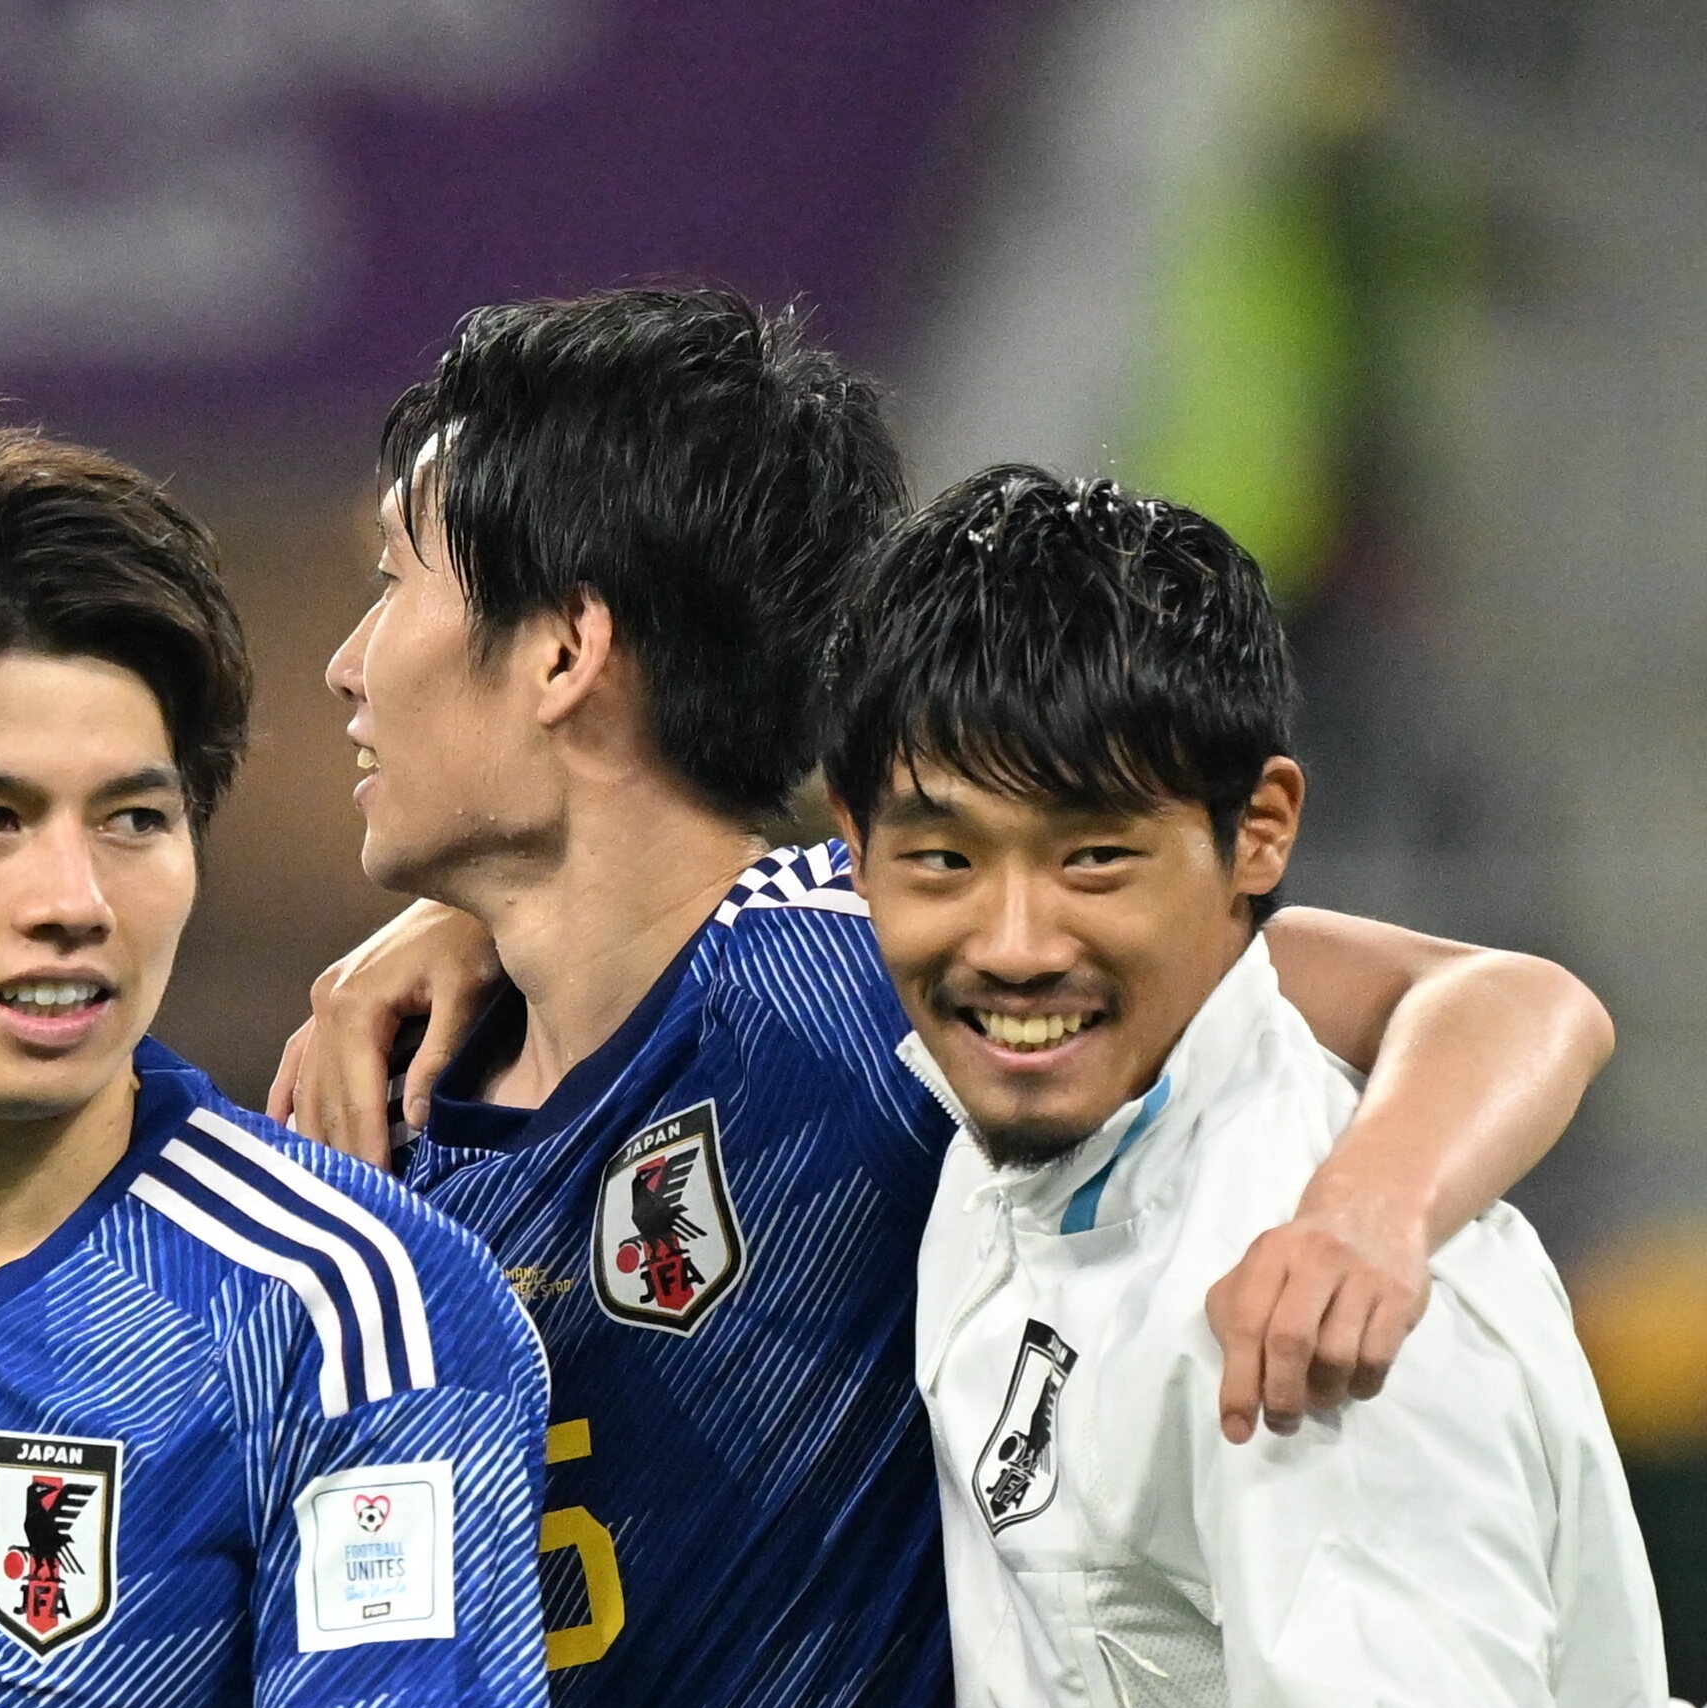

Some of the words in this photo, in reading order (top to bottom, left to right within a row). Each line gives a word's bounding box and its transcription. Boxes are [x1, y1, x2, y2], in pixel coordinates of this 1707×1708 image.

[622, 1121, 682, 1164] JAPAN
[639, 1256, 707, 1304] JFA
[16, 1443, 84, 1465] JAPAN
[986, 1468, 1032, 1510] JFA
[538, 1418, 625, 1670] 5
[347, 1557, 405, 1581] UNITES
[13, 1584, 72, 1619] JFA
